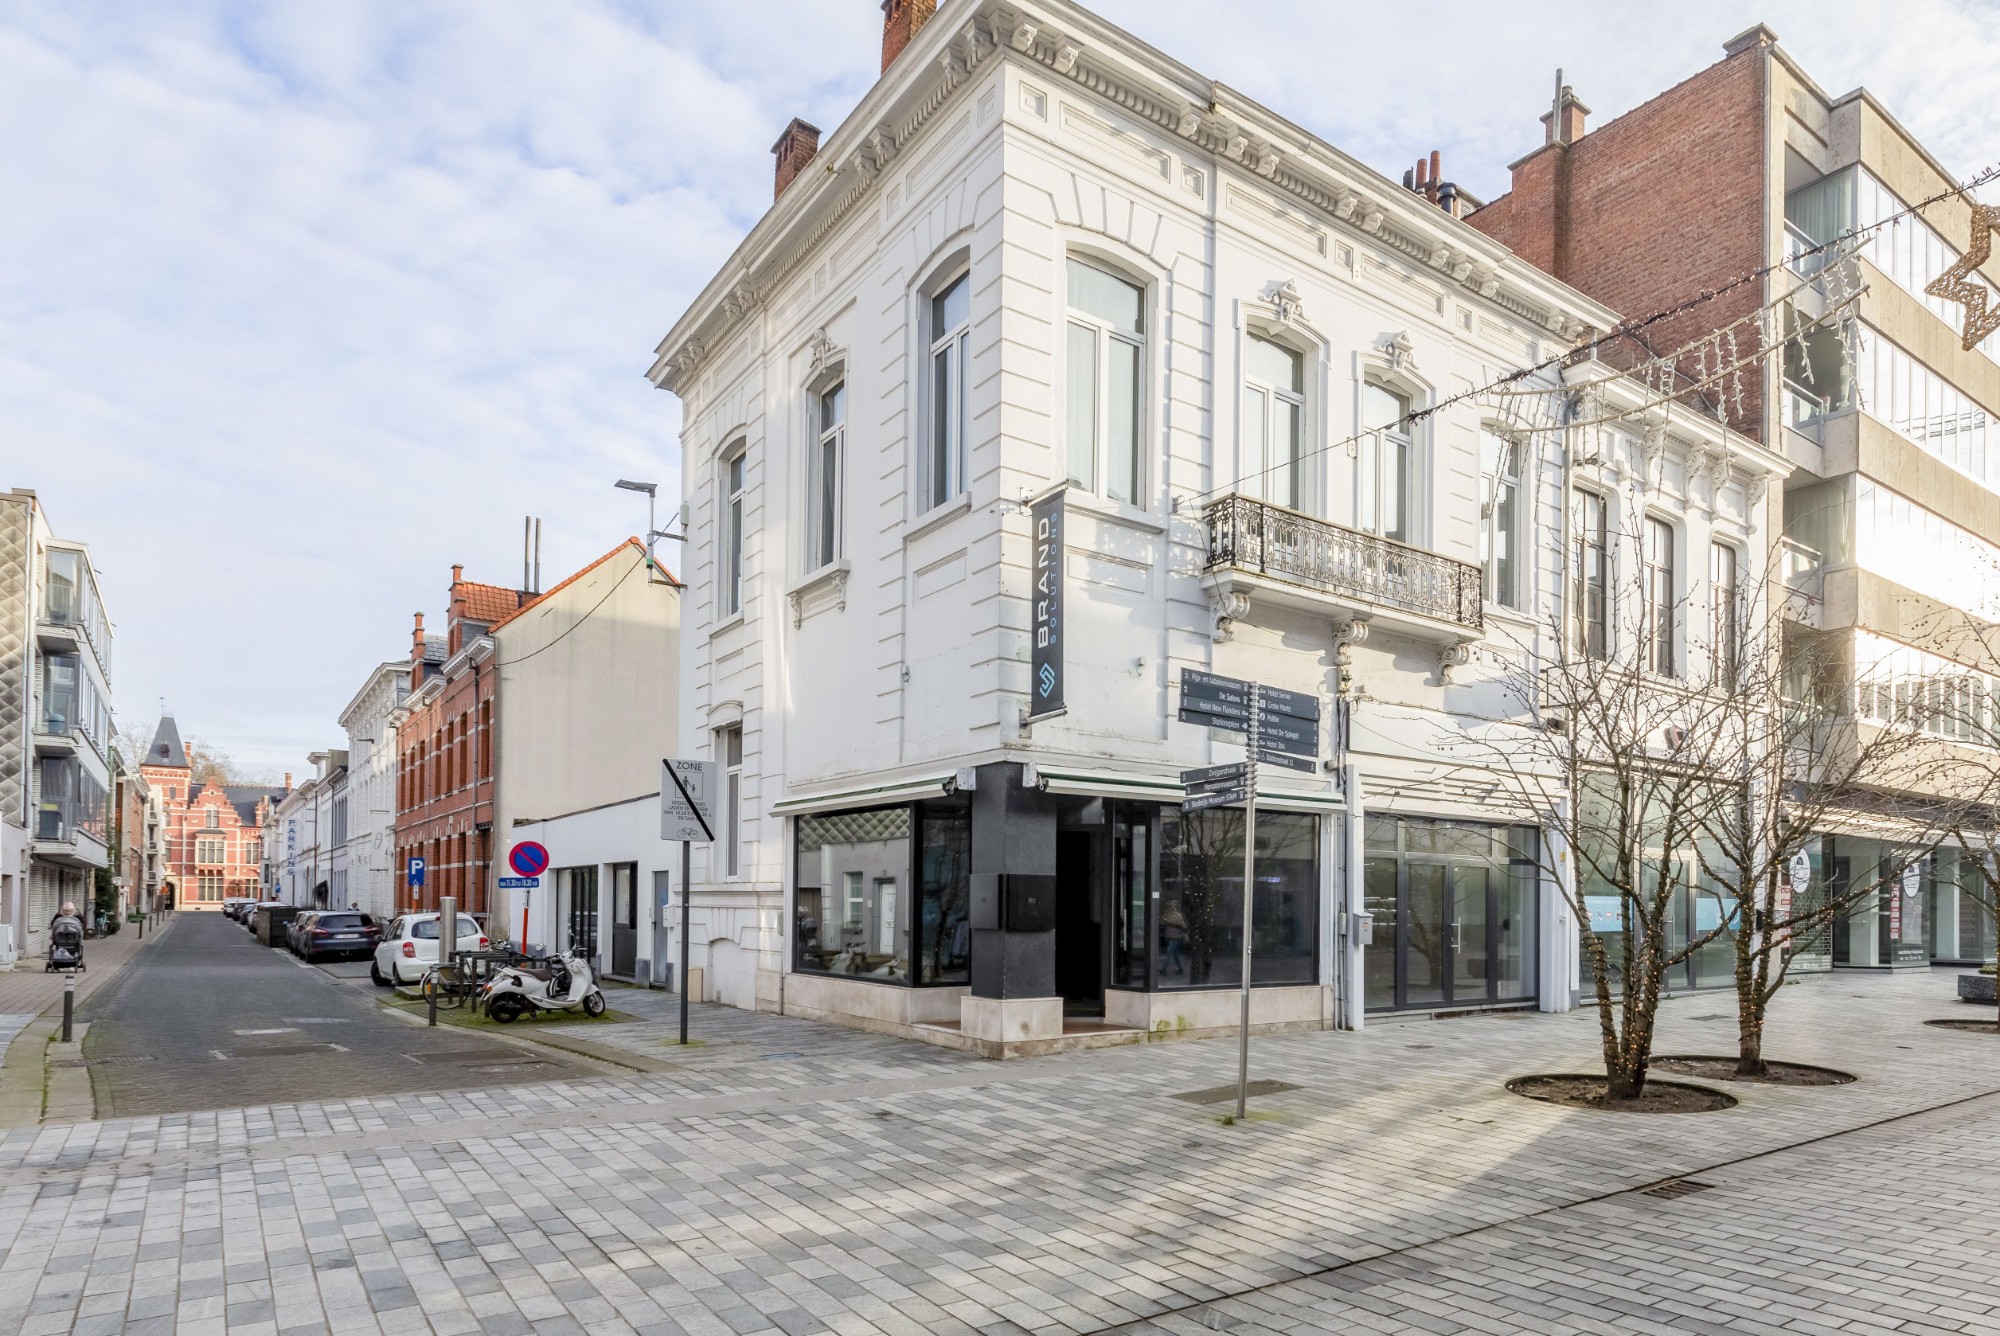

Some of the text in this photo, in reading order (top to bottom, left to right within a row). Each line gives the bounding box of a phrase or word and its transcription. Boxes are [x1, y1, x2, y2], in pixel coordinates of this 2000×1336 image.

[1038, 517, 1049, 649] BRAND
[1219, 692, 1241, 703] De Salons
[1267, 689, 1279, 698] Hotel
[1200, 701, 1240, 716] Hotel New Flanders
[1267, 701, 1292, 713] Grote Markt
[1212, 717, 1240, 729] Stationsplein
[1266, 727, 1300, 741] Hotel De Spiegel
[1266, 740, 1286, 750] Hotel Ibis
[676, 761, 703, 772] ZONE
[1208, 766, 1237, 777] Zwijgershoek
[1203, 780, 1238, 791] Mercatormuseum
[1191, 799, 1208, 808] Stedelijk
[1208, 795, 1225, 804] Museum
[287, 819, 296, 875] PARKING
[411, 860, 424, 875] P
